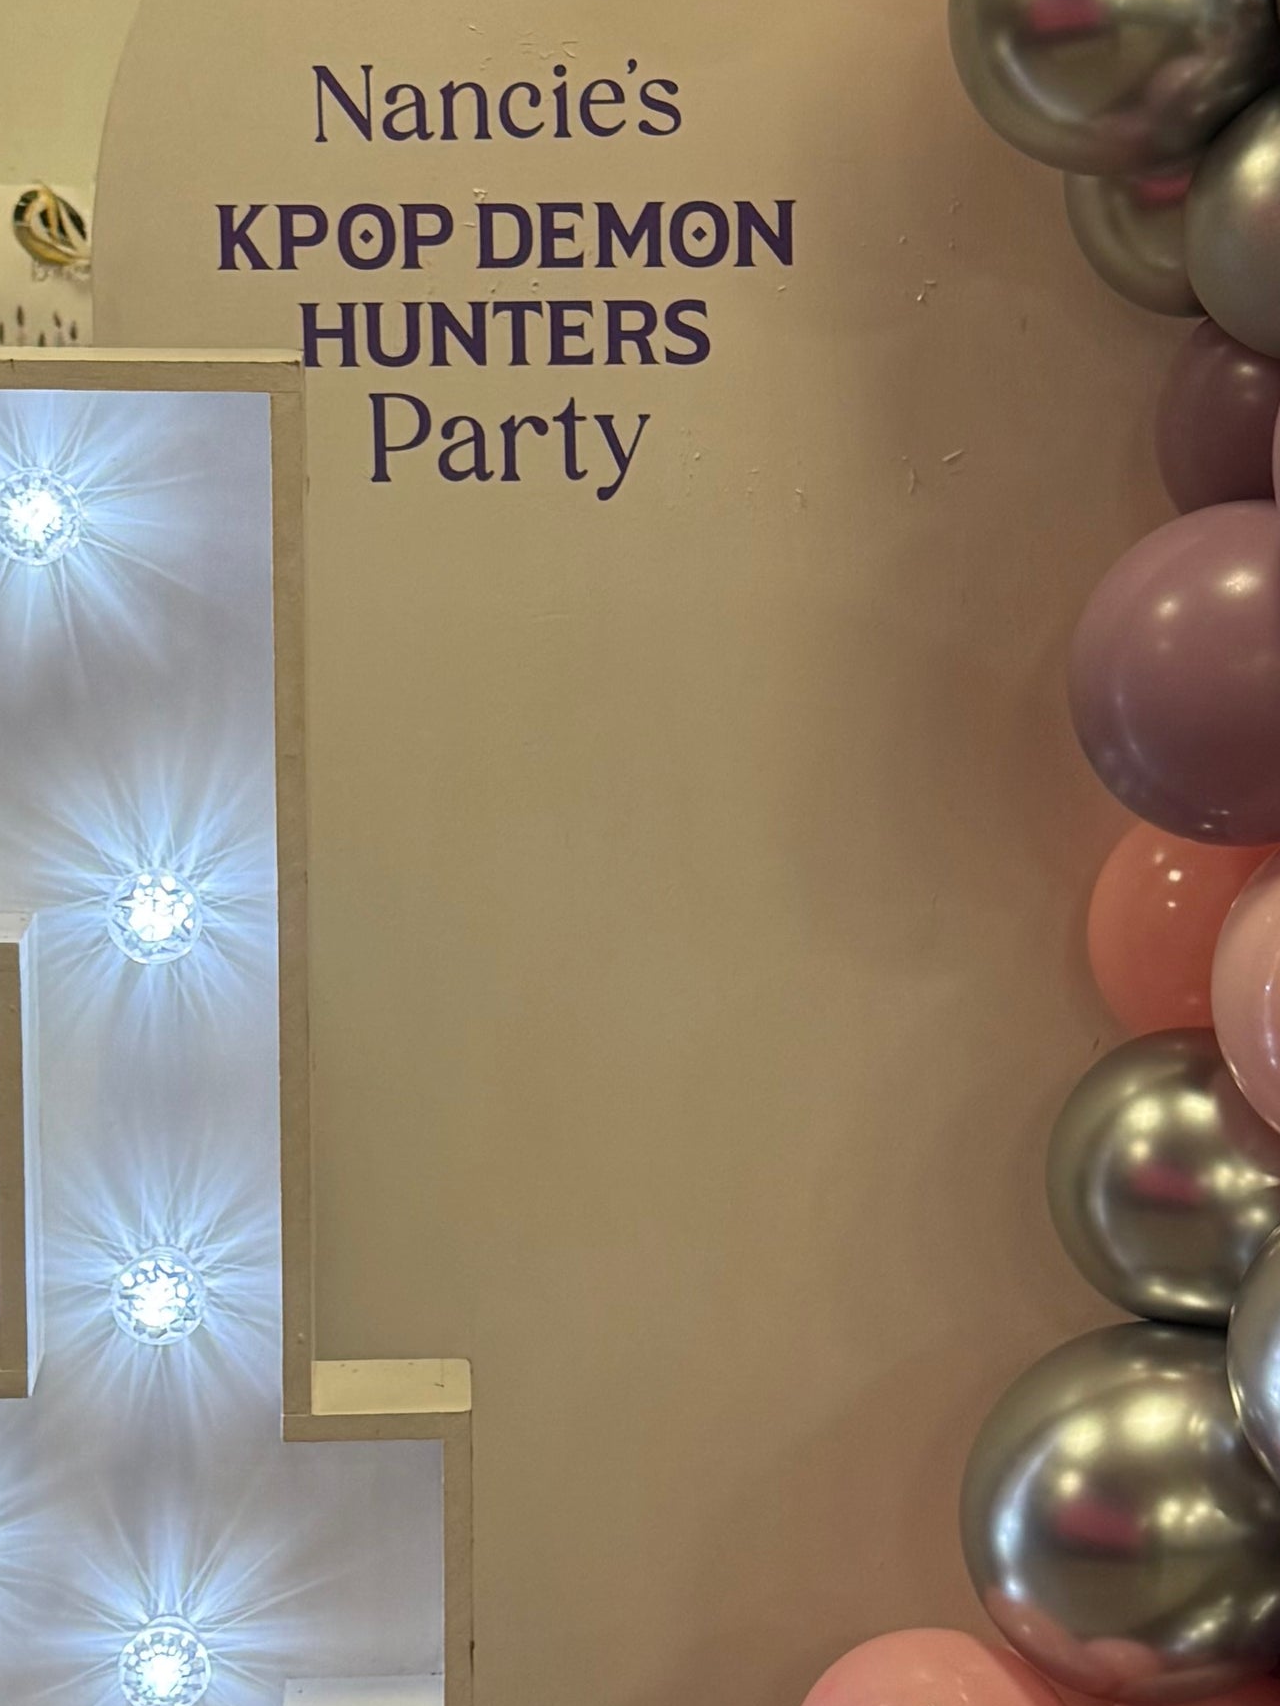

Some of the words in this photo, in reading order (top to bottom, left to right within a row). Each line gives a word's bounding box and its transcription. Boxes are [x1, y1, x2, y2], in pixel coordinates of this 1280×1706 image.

[312, 58, 682, 142] Nancie's
[216, 203, 454, 271] KPOP
[476, 200, 797, 270] DEMON
[300, 299, 711, 369] HUNTERS
[369, 392, 651, 502] Party
